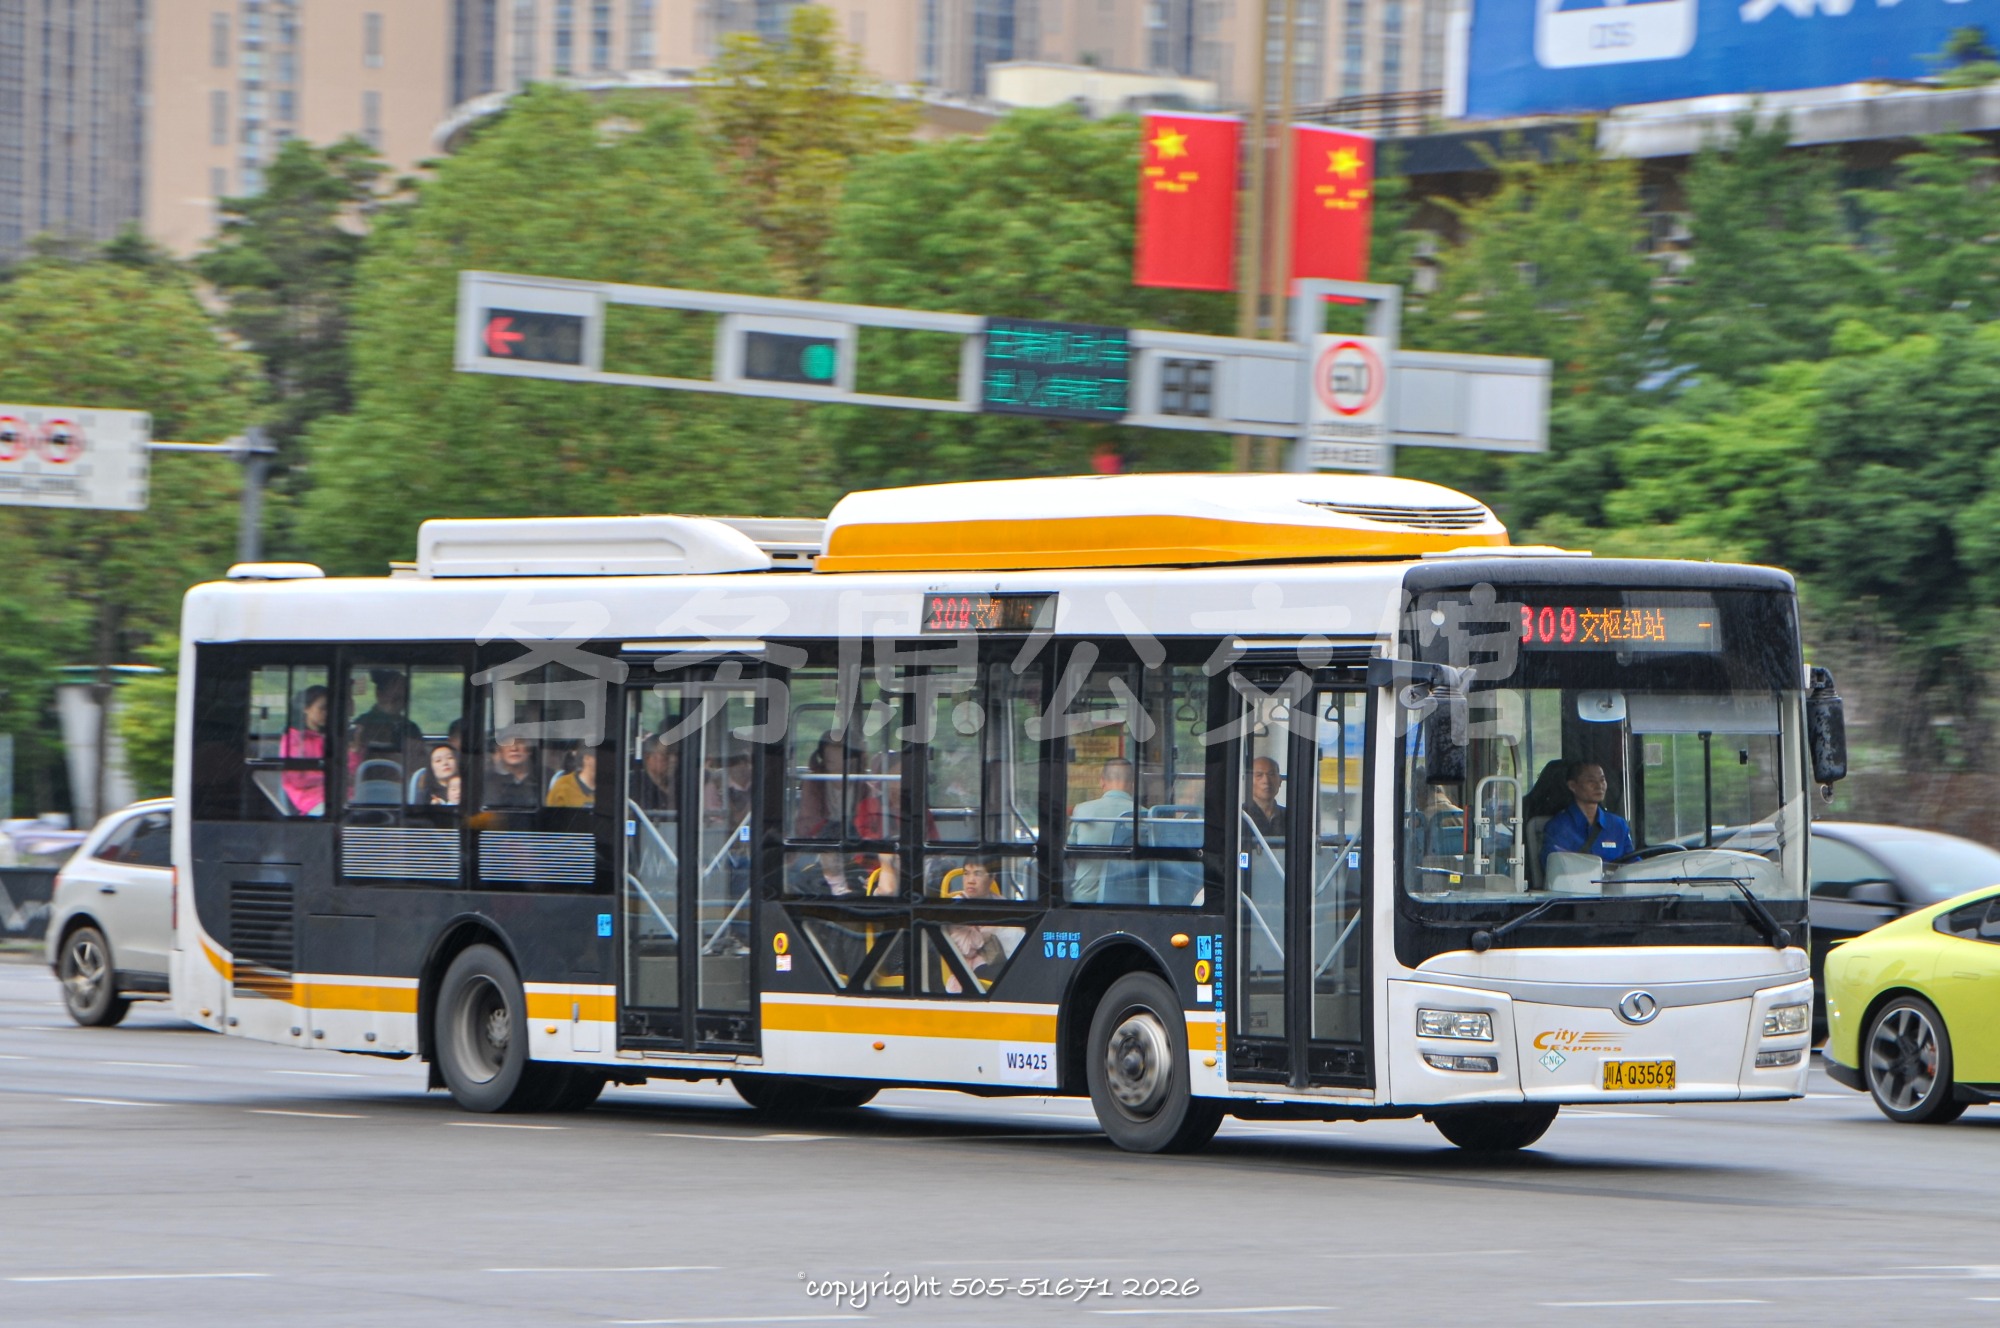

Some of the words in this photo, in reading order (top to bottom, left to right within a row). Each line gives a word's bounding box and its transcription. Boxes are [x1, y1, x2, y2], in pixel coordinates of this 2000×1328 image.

[1521, 605, 1576, 643] 309
[1579, 607, 1665, 642] 交枢纽站
[1533, 1028, 1579, 1050] City
[1550, 1044, 1623, 1052] Express
[1007, 1052, 1048, 1070] W3425
[1543, 1055, 1561, 1066] CNG
